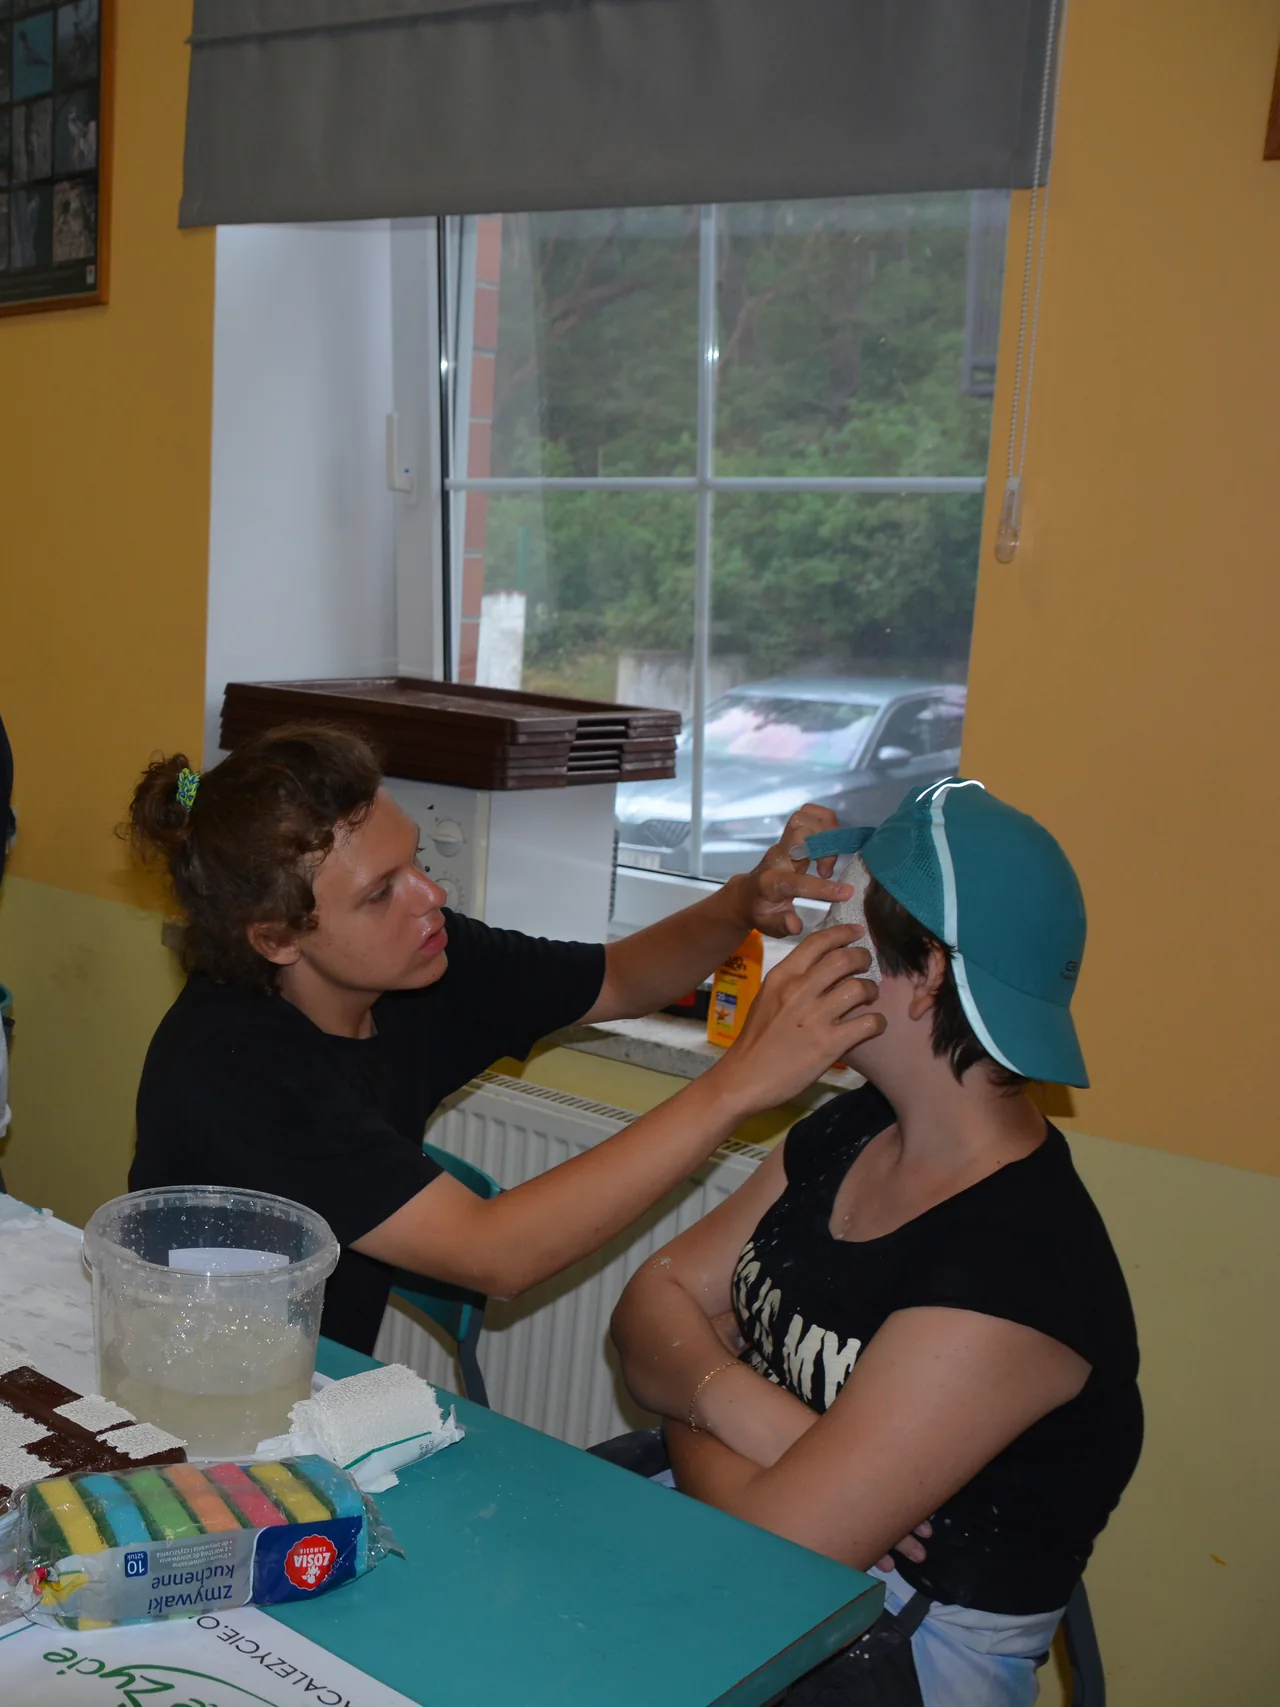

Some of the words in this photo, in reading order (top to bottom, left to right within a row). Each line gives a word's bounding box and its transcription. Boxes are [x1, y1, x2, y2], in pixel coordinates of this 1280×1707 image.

[126, 1552, 144, 1561] sztuk
[300, 1546, 326, 1554] SAMOSIA
[127, 1560, 146, 1575] 10
[293, 1552, 331, 1568] ZOSIA
[151, 1564, 235, 1590] kuchenne
[147, 1585, 233, 1614] zmywaki
[188, 1614, 350, 1707] CALEZYCIE.O
